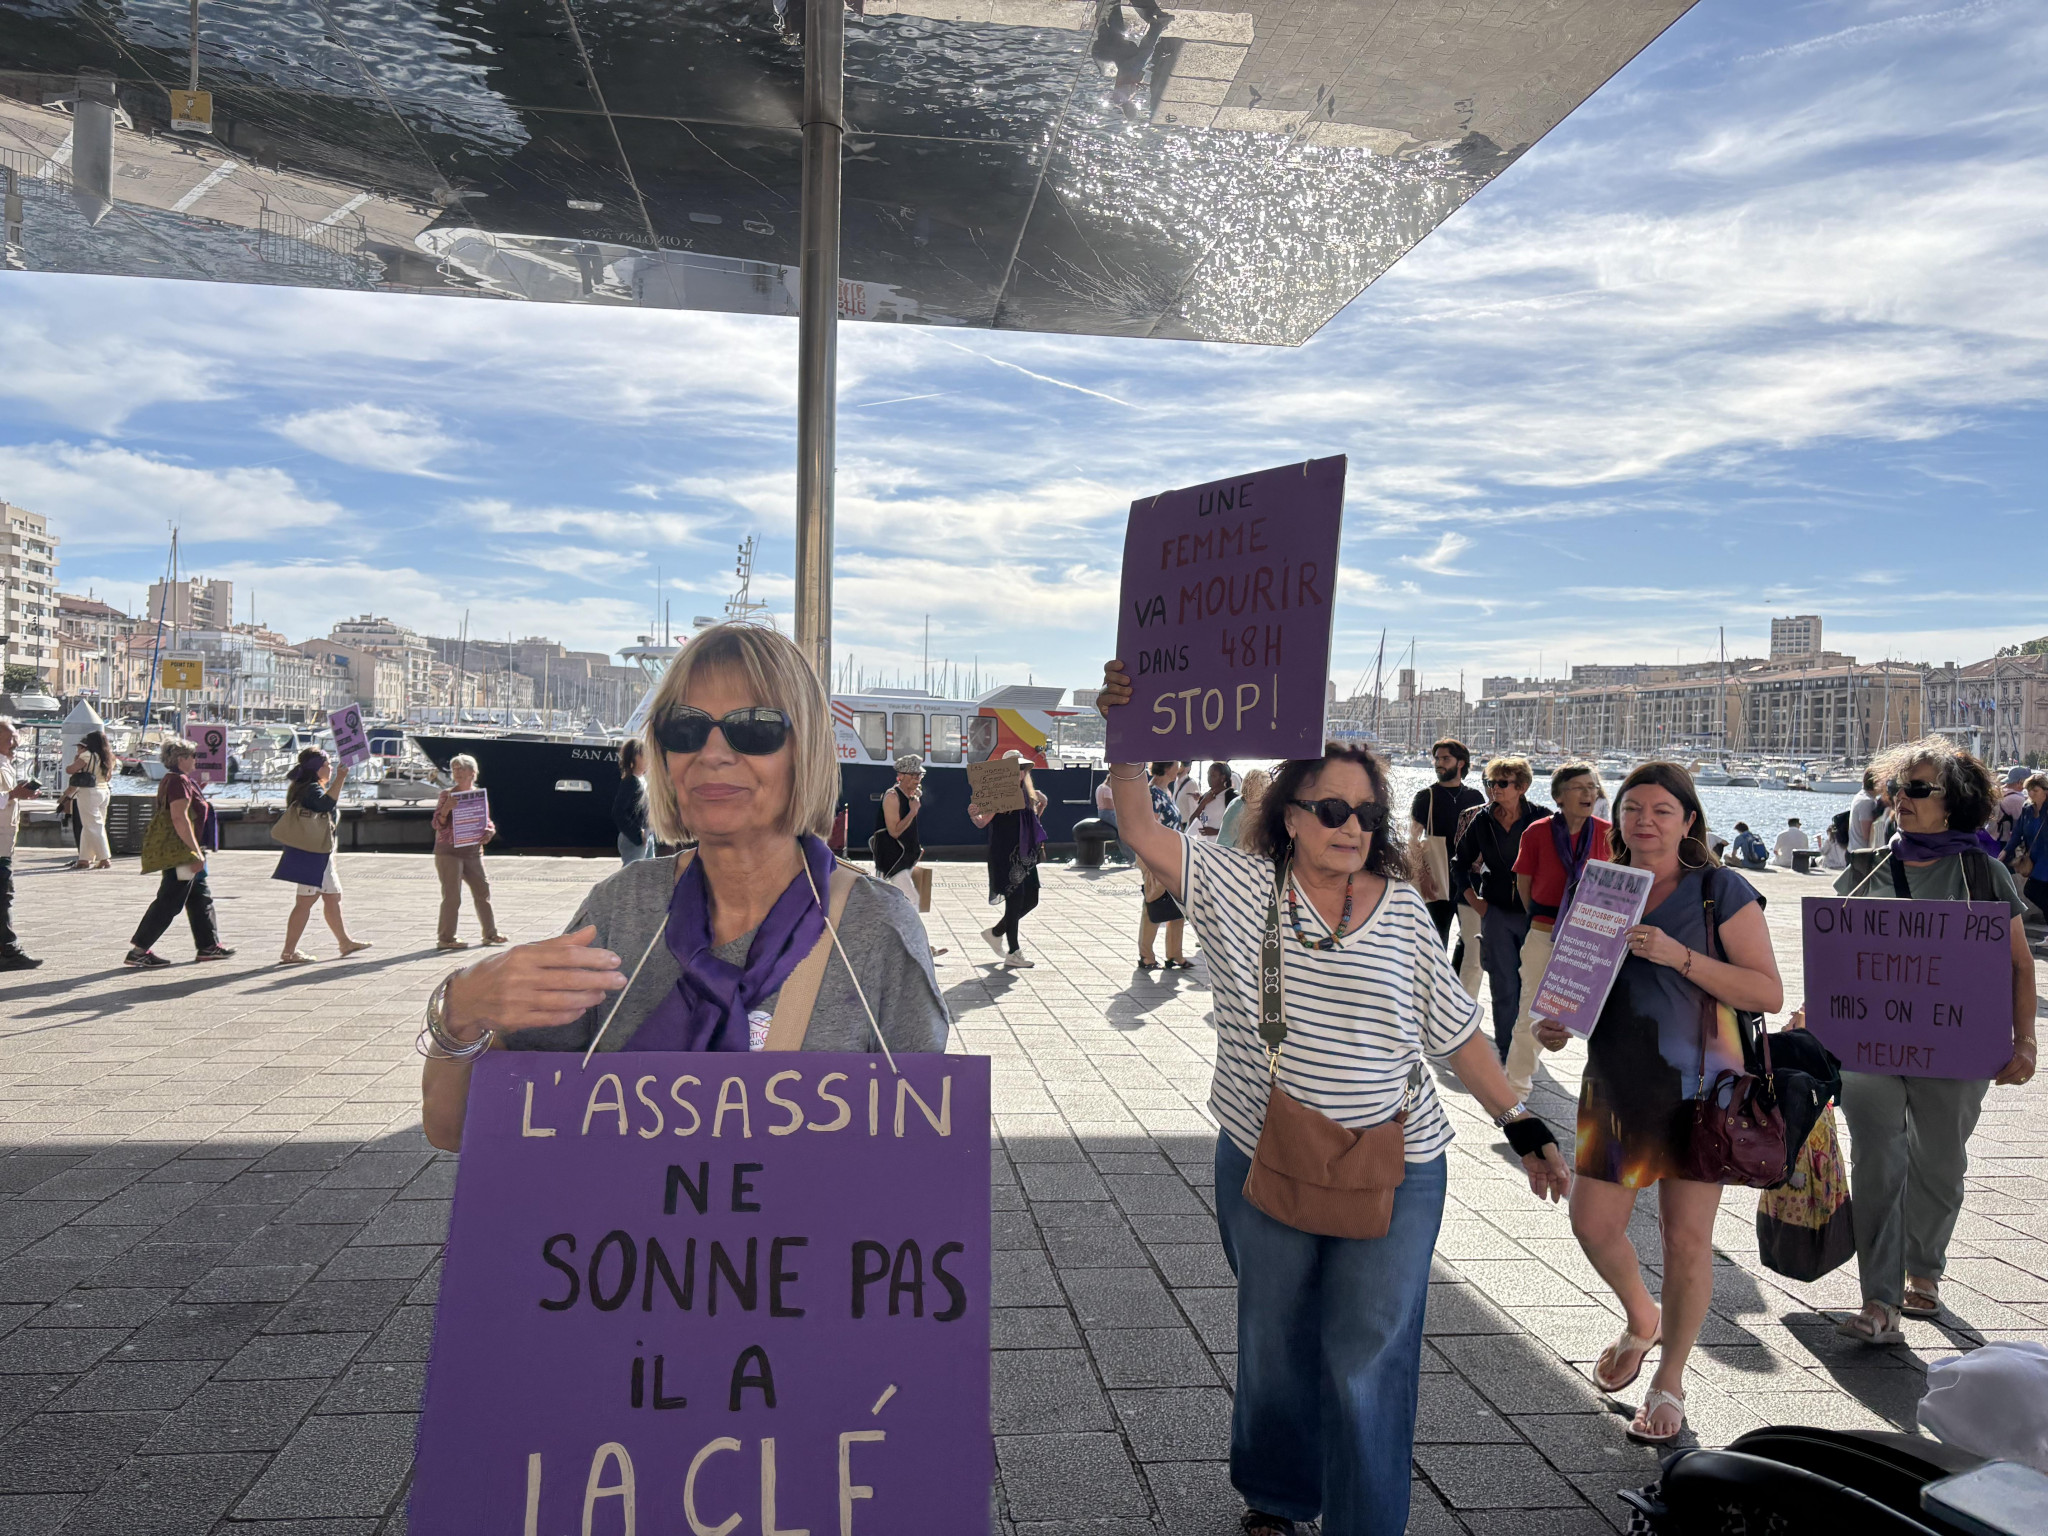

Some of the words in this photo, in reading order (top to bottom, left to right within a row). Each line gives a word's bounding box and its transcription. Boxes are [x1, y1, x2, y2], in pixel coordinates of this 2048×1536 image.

[1198, 482, 1255, 517] UNE
[1161, 517, 1267, 569] FEMME
[1134, 595, 1167, 628] VA
[1137, 644, 1190, 676] DANS
[1221, 624, 1283, 669] 48H
[571, 748, 602, 760] SAN
[603, 751, 624, 762] AN
[837, 743, 857, 759] tte
[1591, 909, 1615, 921] passer
[1814, 907, 1853, 934] ON
[1864, 909, 1890, 936] NE
[1898, 911, 1950, 939] NAIT
[1963, 914, 2005, 942] PAS
[1856, 951, 1942, 985] FEMME
[1830, 995, 1867, 1020] MAIS
[1884, 999, 1912, 1023] ON
[1933, 1003, 1963, 1028] EN
[1857, 1041, 1935, 1069] MEURT
[663, 1161, 764, 1216] NE
[539, 1229, 809, 1318] SONNE
[851, 1238, 967, 1322] PAS
[728, 1344, 776, 1412] A
[683, 1383, 898, 1536] CLÉ
